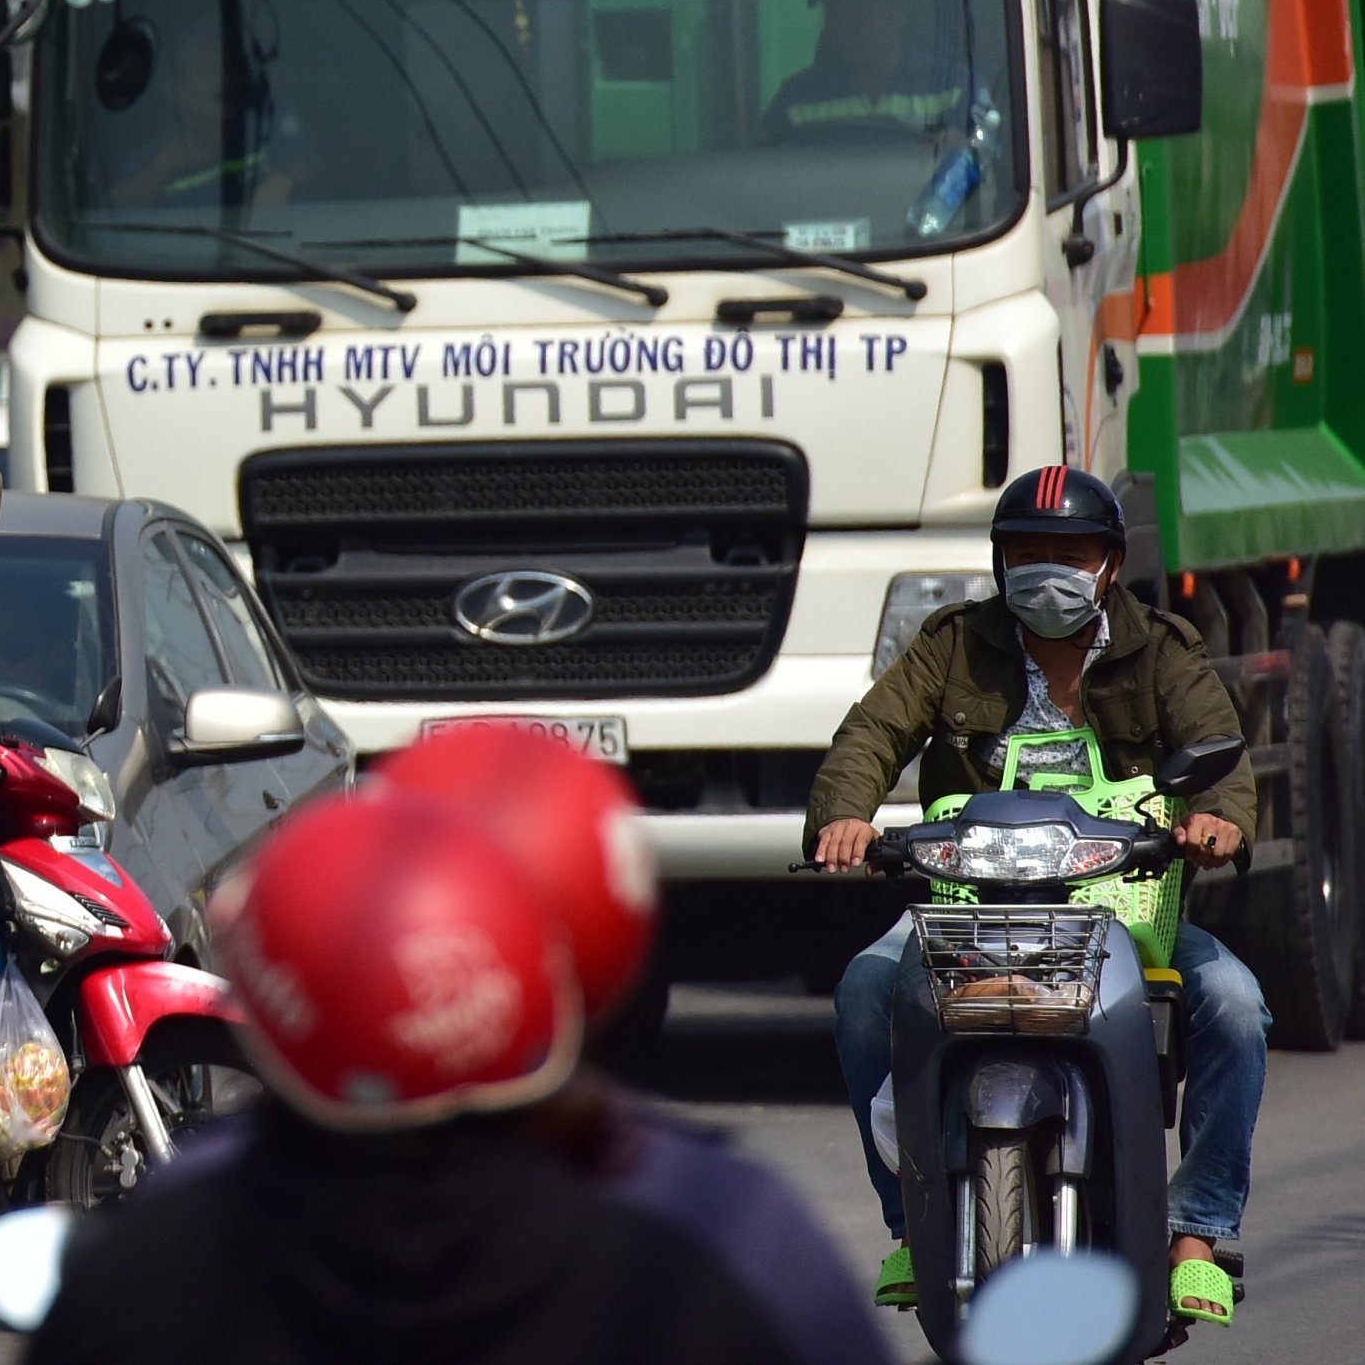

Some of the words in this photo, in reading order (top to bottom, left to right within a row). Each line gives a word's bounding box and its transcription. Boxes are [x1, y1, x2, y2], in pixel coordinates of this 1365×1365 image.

[229, 345, 325, 386] TNHH
[344, 341, 421, 381] MTV
[442, 332, 513, 378] MÔI
[534, 323, 685, 375] TRƯỜNG
[703, 328, 754, 371] ĐÔ
[775, 334, 837, 382] THỊ
[860, 334, 908, 373] TP
[260, 372, 775, 433] HYUNDAI
